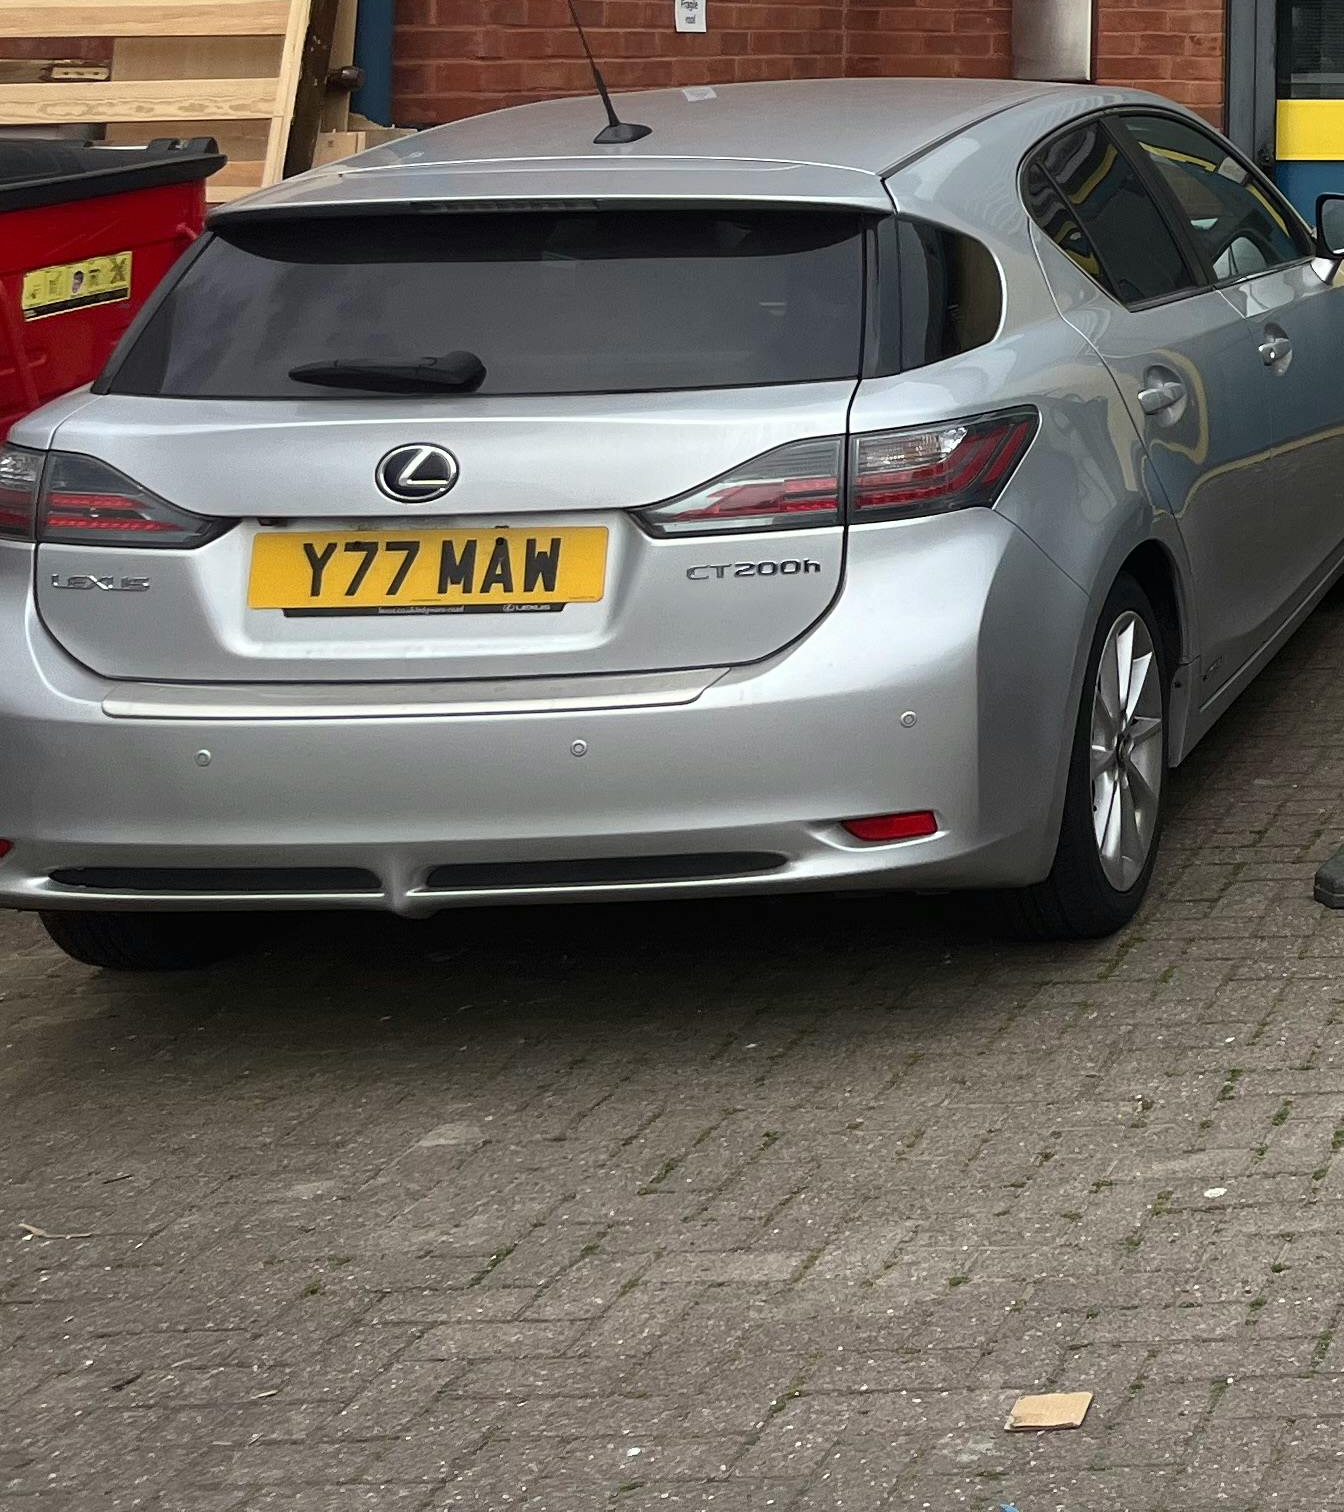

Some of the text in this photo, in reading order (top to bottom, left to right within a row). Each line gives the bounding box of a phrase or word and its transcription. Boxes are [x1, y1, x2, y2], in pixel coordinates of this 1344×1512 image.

[51, 573, 150, 592] LEXUS
[303, 537, 562, 597] Y77 MAW
